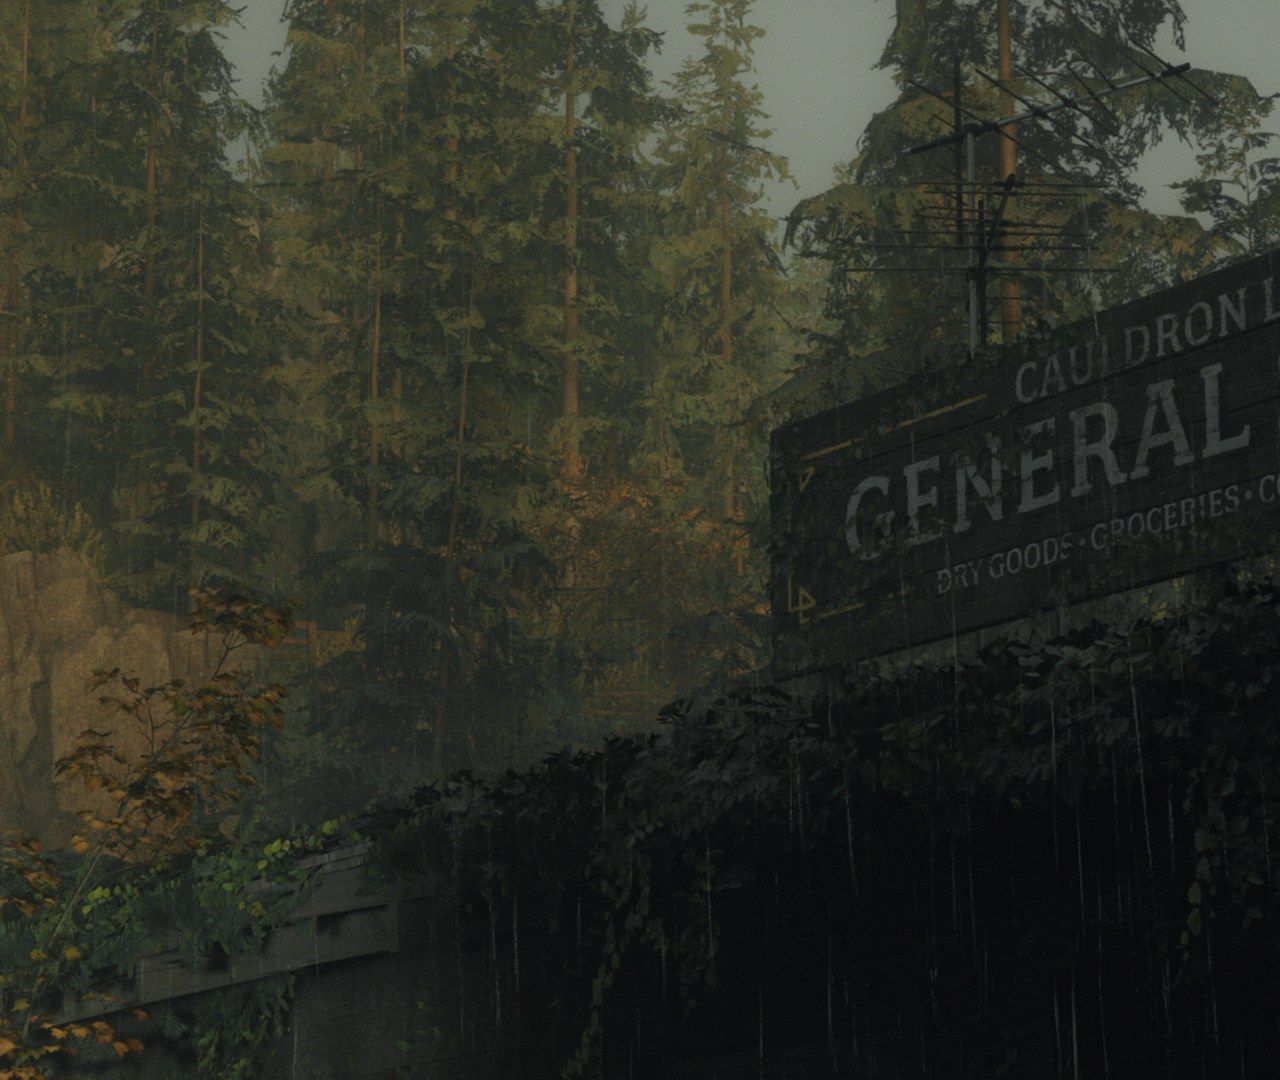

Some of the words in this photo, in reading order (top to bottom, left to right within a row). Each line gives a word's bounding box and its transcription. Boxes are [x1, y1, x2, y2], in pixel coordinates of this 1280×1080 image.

[1015, 285, 1247, 404] CAULDRON
[844, 362, 1251, 561] GENERAL
[936, 559, 984, 595] DRY
[988, 532, 1073, 580] GOODS
[1090, 484, 1240, 551] GROCERIES
